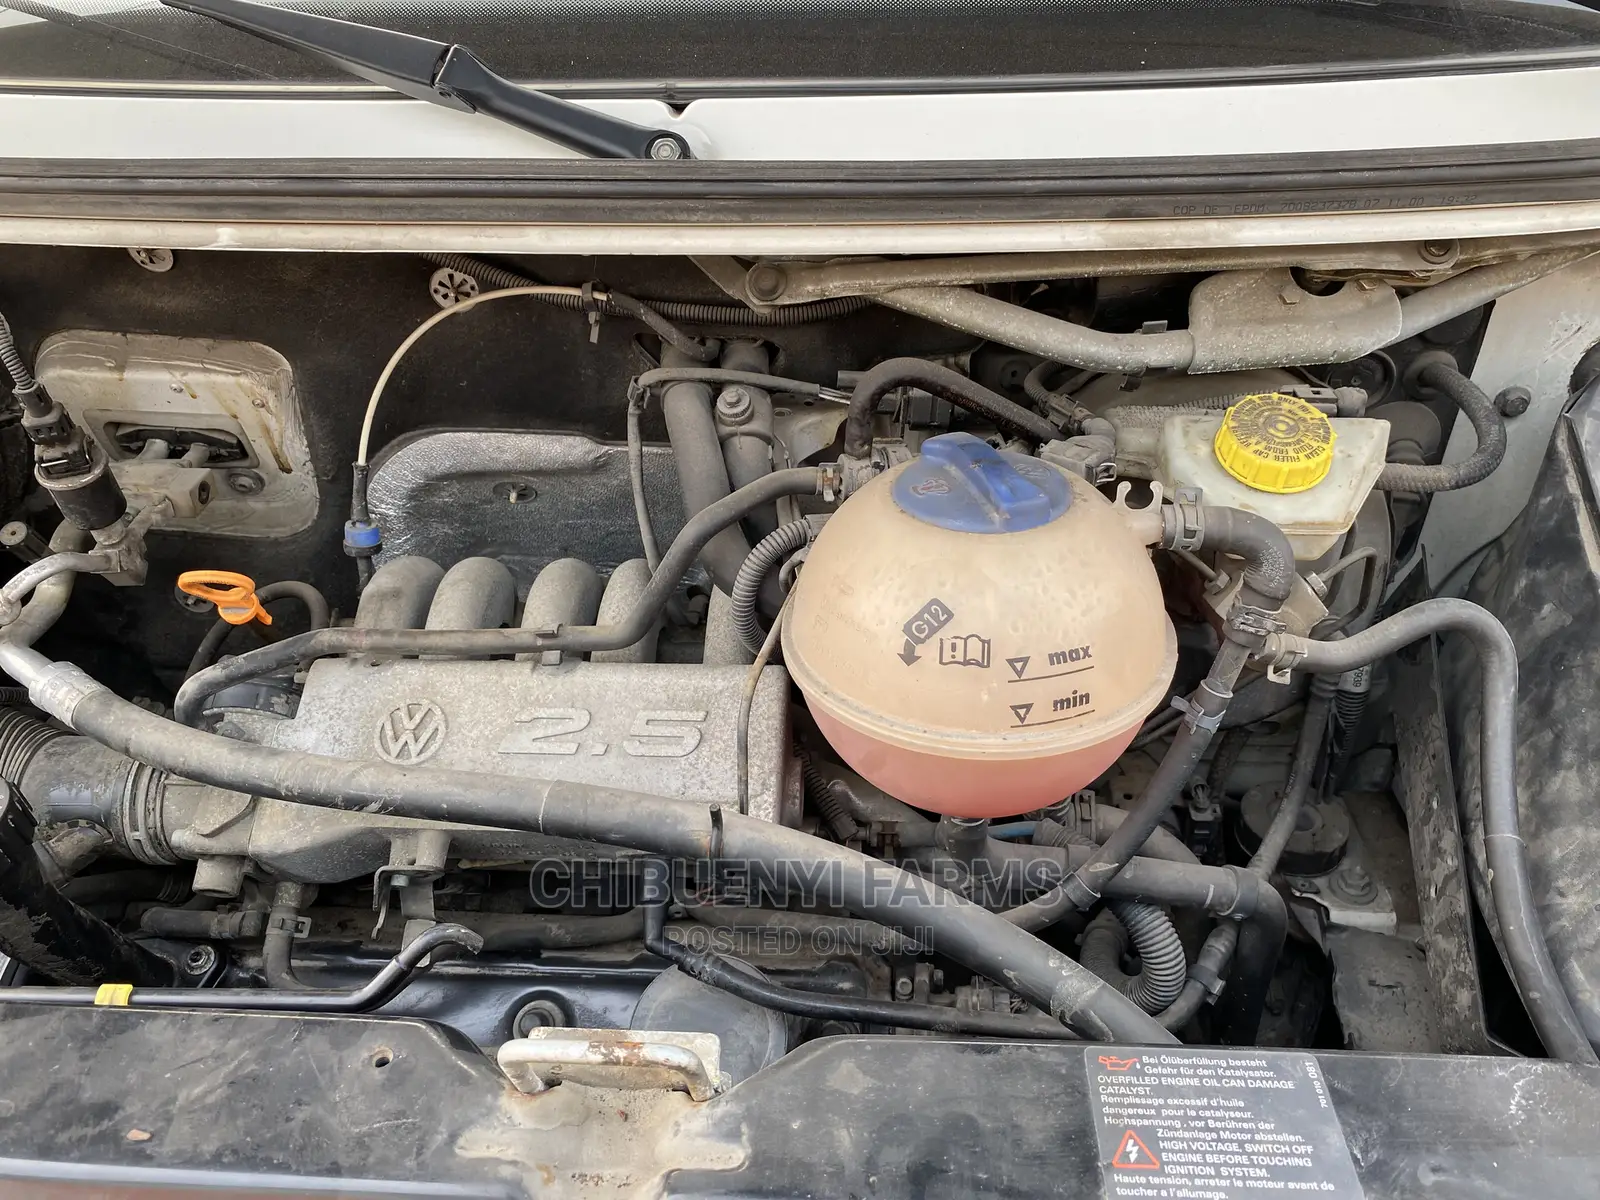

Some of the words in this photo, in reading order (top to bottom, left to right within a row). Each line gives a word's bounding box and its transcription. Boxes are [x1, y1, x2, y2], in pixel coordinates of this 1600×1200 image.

[1253, 449, 1270, 459] CAP
[1264, 445, 1289, 455] FROM
[1292, 442, 1314, 455] FLUID
[1304, 445, 1326, 460] CLEAN
[1274, 455, 1301, 463] FILLER
[911, 604, 949, 639] G12
[1048, 644, 1093, 667] max
[1052, 689, 1092, 713] min
[498, 707, 710, 758] 2.5
[1141, 1055, 1158, 1064] Bei
[1160, 1055, 1227, 1067] Ölüberfüllung
[1227, 1057, 1267, 1067] besteht
[1144, 1065, 1178, 1075] Gefahr
[1180, 1065, 1194, 1075] für
[1196, 1067, 1215, 1076] den
[1217, 1067, 1277, 1078] Katalysator.
[1097, 1075, 1159, 1085] OVERFILLED
[1161, 1078, 1201, 1087] ENGINE
[1202, 1079, 1221, 1087] OIL
[1222, 1079, 1246, 1088] CAN
[1247, 1080, 1296, 1090] DAMAGE
[1098, 1085, 1154, 1096] CATALYST.
[1100, 1094, 1164, 1106] Remplissage
[1166, 1098, 1208, 1106] excessif
[1209, 1097, 1245, 1108] d'huile
[1102, 1105, 1157, 1117] dangereux
[1161, 1109, 1185, 1117] pour
[1186, 1107, 1197, 1117] le
[1198, 1108, 1255, 1119] catalyseur.
[1188, 1120, 1206, 1128] vor
[1207, 1119, 1256, 1129] Berühren
[1257, 1121, 1276, 1131] der
[1156, 1128, 1218, 1140] Zündanlage
[1219, 1131, 1252, 1140] Motor
[1254, 1132, 1306, 1142] abstellen.
[1159, 1140, 1188, 1150] HIGH
[1244, 1143, 1291, 1154] SWITCH
[1291, 1145, 1314, 1155] OFF
[1161, 1152, 1204, 1163] ENGINE
[1205, 1154, 1250, 1165] BEFORE
[1250, 1155, 1313, 1167] TOUCHING
[1164, 1164, 1216, 1176] IGNITION
[1220, 1166, 1271, 1178] SYSTEM.
[1113, 1173, 1147, 1184] Haute
[1148, 1175, 1192, 1186] tension,
[1194, 1178, 1231, 1187] arreter
[1232, 1178, 1244, 1187] le
[1245, 1178, 1285, 1189] moteur
[1287, 1181, 1319, 1191] avant
[1320, 1180, 1336, 1191] de
[1115, 1186, 1159, 1197] toucher
[1160, 1189, 1168, 1197] a
[1169, 1187, 1229, 1200] l'allumage.
